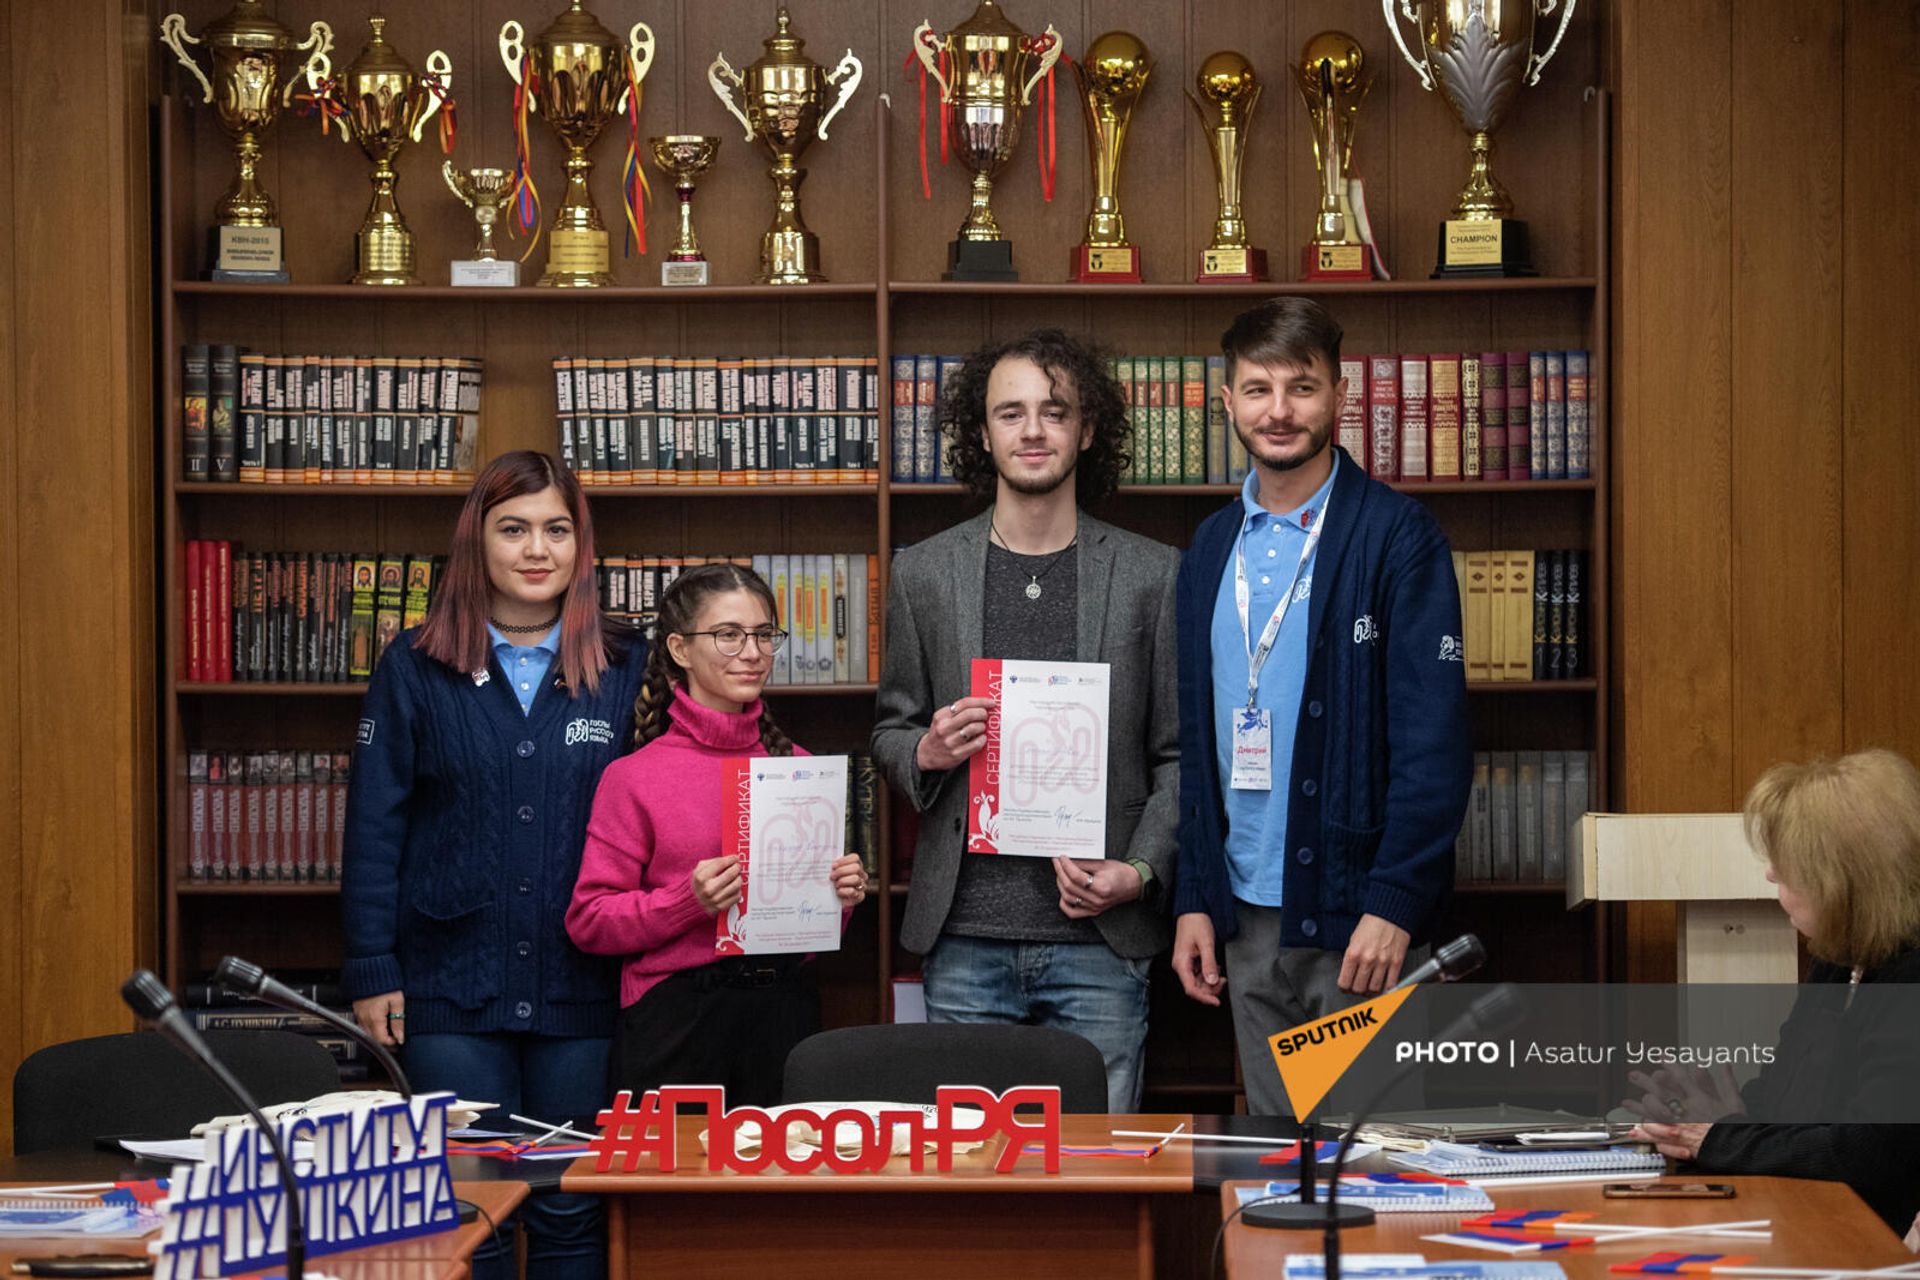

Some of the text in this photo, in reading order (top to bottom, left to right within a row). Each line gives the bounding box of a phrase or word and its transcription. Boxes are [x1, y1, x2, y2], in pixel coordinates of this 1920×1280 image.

[1450, 233, 1498, 244] CHAMPION
[192, 459, 201, 471] II
[216, 458, 227, 471] V
[643, 571, 654, 608] БЕРЛИН
[1237, 745, 1267, 755] Дмитрий
